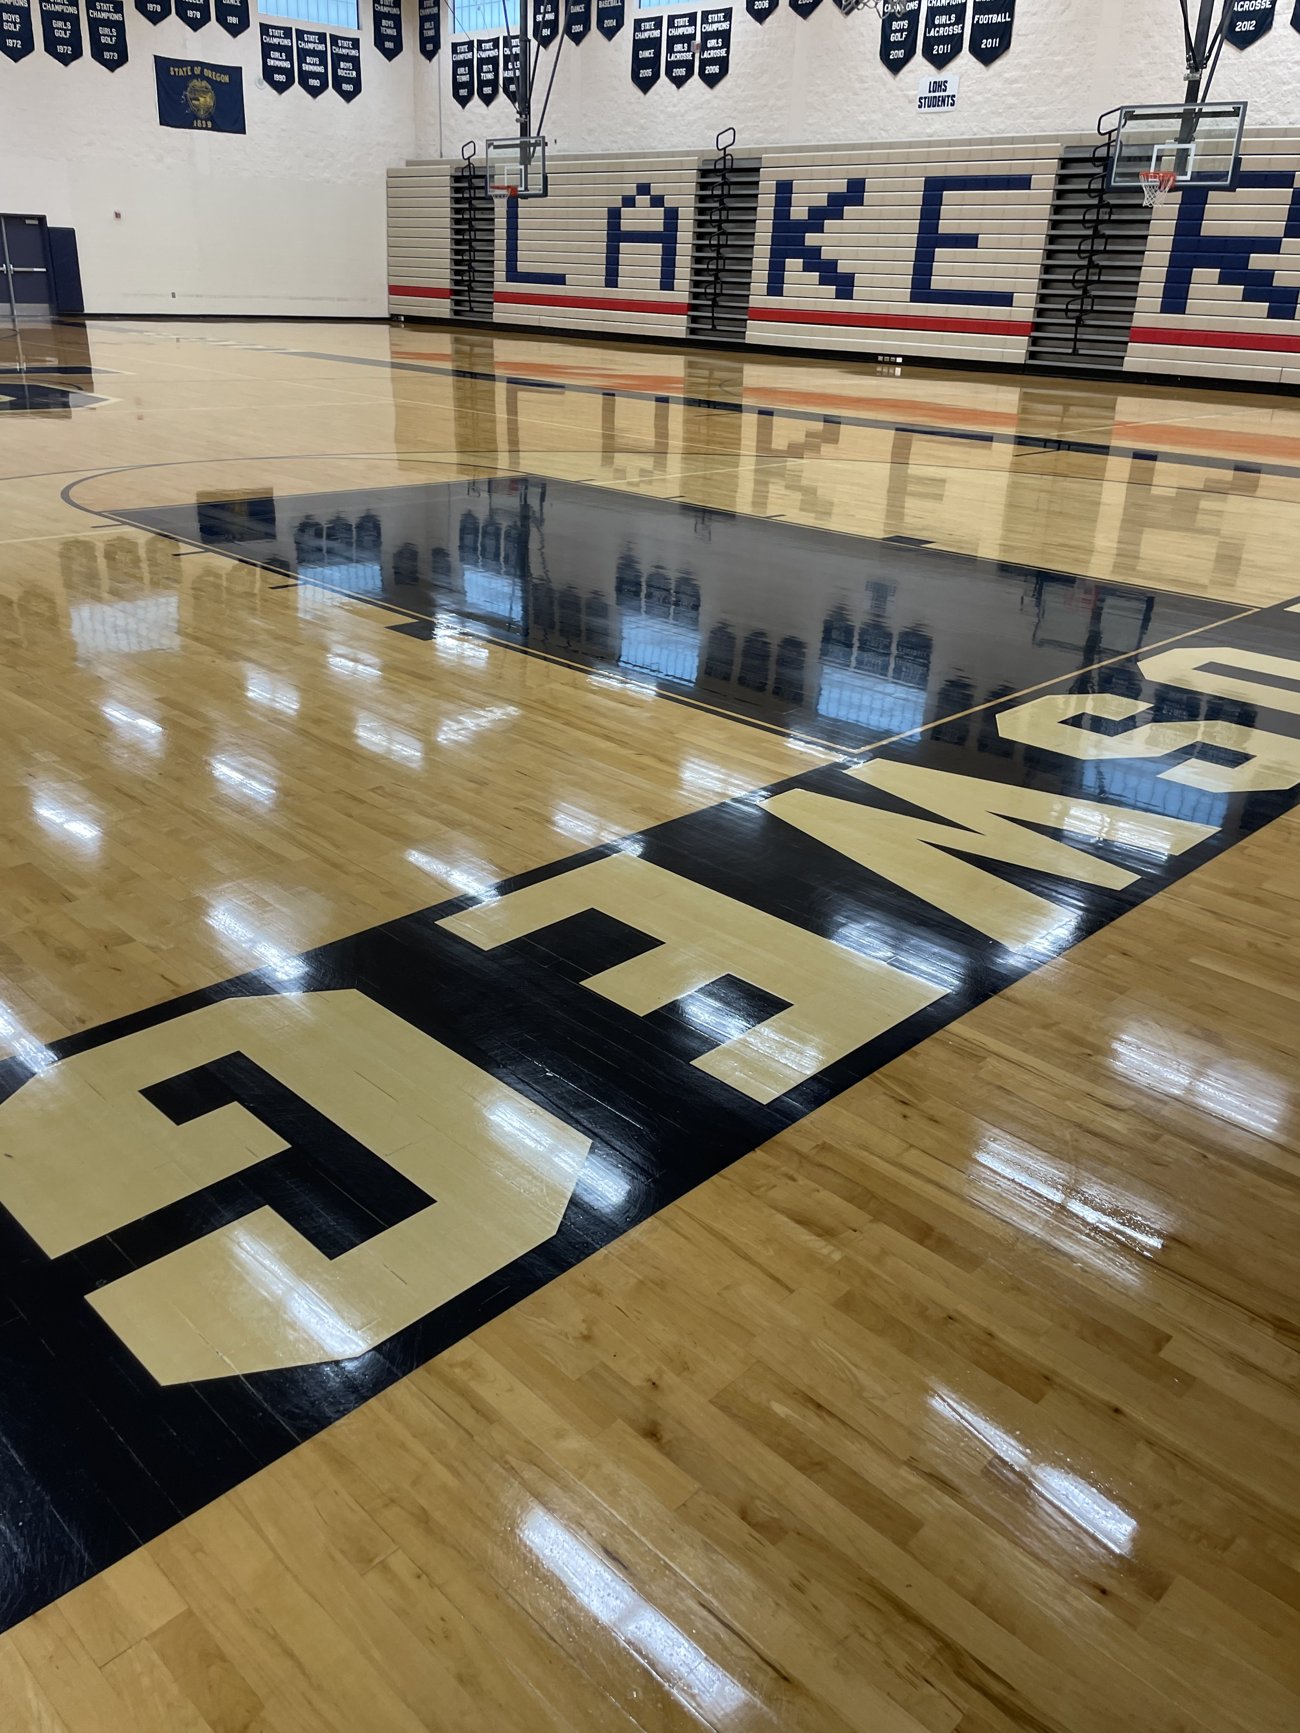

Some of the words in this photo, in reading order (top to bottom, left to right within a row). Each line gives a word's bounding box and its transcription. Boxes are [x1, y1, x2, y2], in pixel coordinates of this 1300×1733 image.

[42, 2, 78, 14] CHAMPIONS
[96, 2, 114, 12] STATE
[540, 4, 551, 12] BYS
[570, 4, 585, 13] DANCE
[1234, 0, 1272, 12] ACROSSE
[2, 12, 20, 22] BOYS
[89, 10, 122, 20] CHAMPIONS
[708, 14, 725, 22] STATE
[934, 14, 956, 24] GIRLS
[974, 12, 1011, 24] FOOTBALL
[3, 22, 20, 31] GOLF
[52, 20, 71, 30] GIRLS
[641, 22, 655, 30] STATE
[674, 18, 690, 26] STATE
[702, 22, 730, 32] CHAMPIONS
[892, 20, 908, 30] BOYS
[1235, 20, 1256, 32] 2012
[54, 30, 71, 38] GOLF
[99, 26, 116, 36] GIRLS
[269, 28, 284, 37] STATE
[542, 28, 551, 36] 994
[635, 30, 660, 39] CHAMPIONS
[668, 26, 696, 36] CHAMPIONS
[926, 24, 962, 36] LACROSSE
[100, 36, 116, 44] GOLF
[262, 36, 291, 46] CHAMPIONS
[304, 34, 319, 42] STATE
[890, 32, 908, 42] GOLF
[6, 38, 22, 48] 1972
[298, 41, 326, 50] CHAMPIONS
[338, 40, 352, 48] STATE
[674, 44, 688, 52] GIRLS
[707, 38, 722, 48] GIRLS
[981, 38, 1000, 48] 2011
[57, 46, 72, 54] 1972
[332, 46, 358, 56] CHAMPIONS
[639, 50, 654, 58] DANCE
[700, 48, 728, 58] LACROSSE
[933, 44, 952, 54] 2011
[104, 52, 118, 60] 1973
[270, 51, 286, 60] GIRLS
[668, 52, 692, 61] LACROSSE
[890, 50, 904, 59] 2010
[266, 58, 290, 68] SWIMMING
[306, 56, 320, 64] BOYS
[302, 64, 324, 72] SWIMMING
[338, 68, 356, 78] SOCCER
[705, 66, 720, 74] 2006
[170, 66, 192, 76] STATE
[194, 66, 201, 75] OF
[204, 68, 230, 83] OREGON
[928, 80, 948, 93] LOHS
[918, 94, 956, 108] STUDENTS
